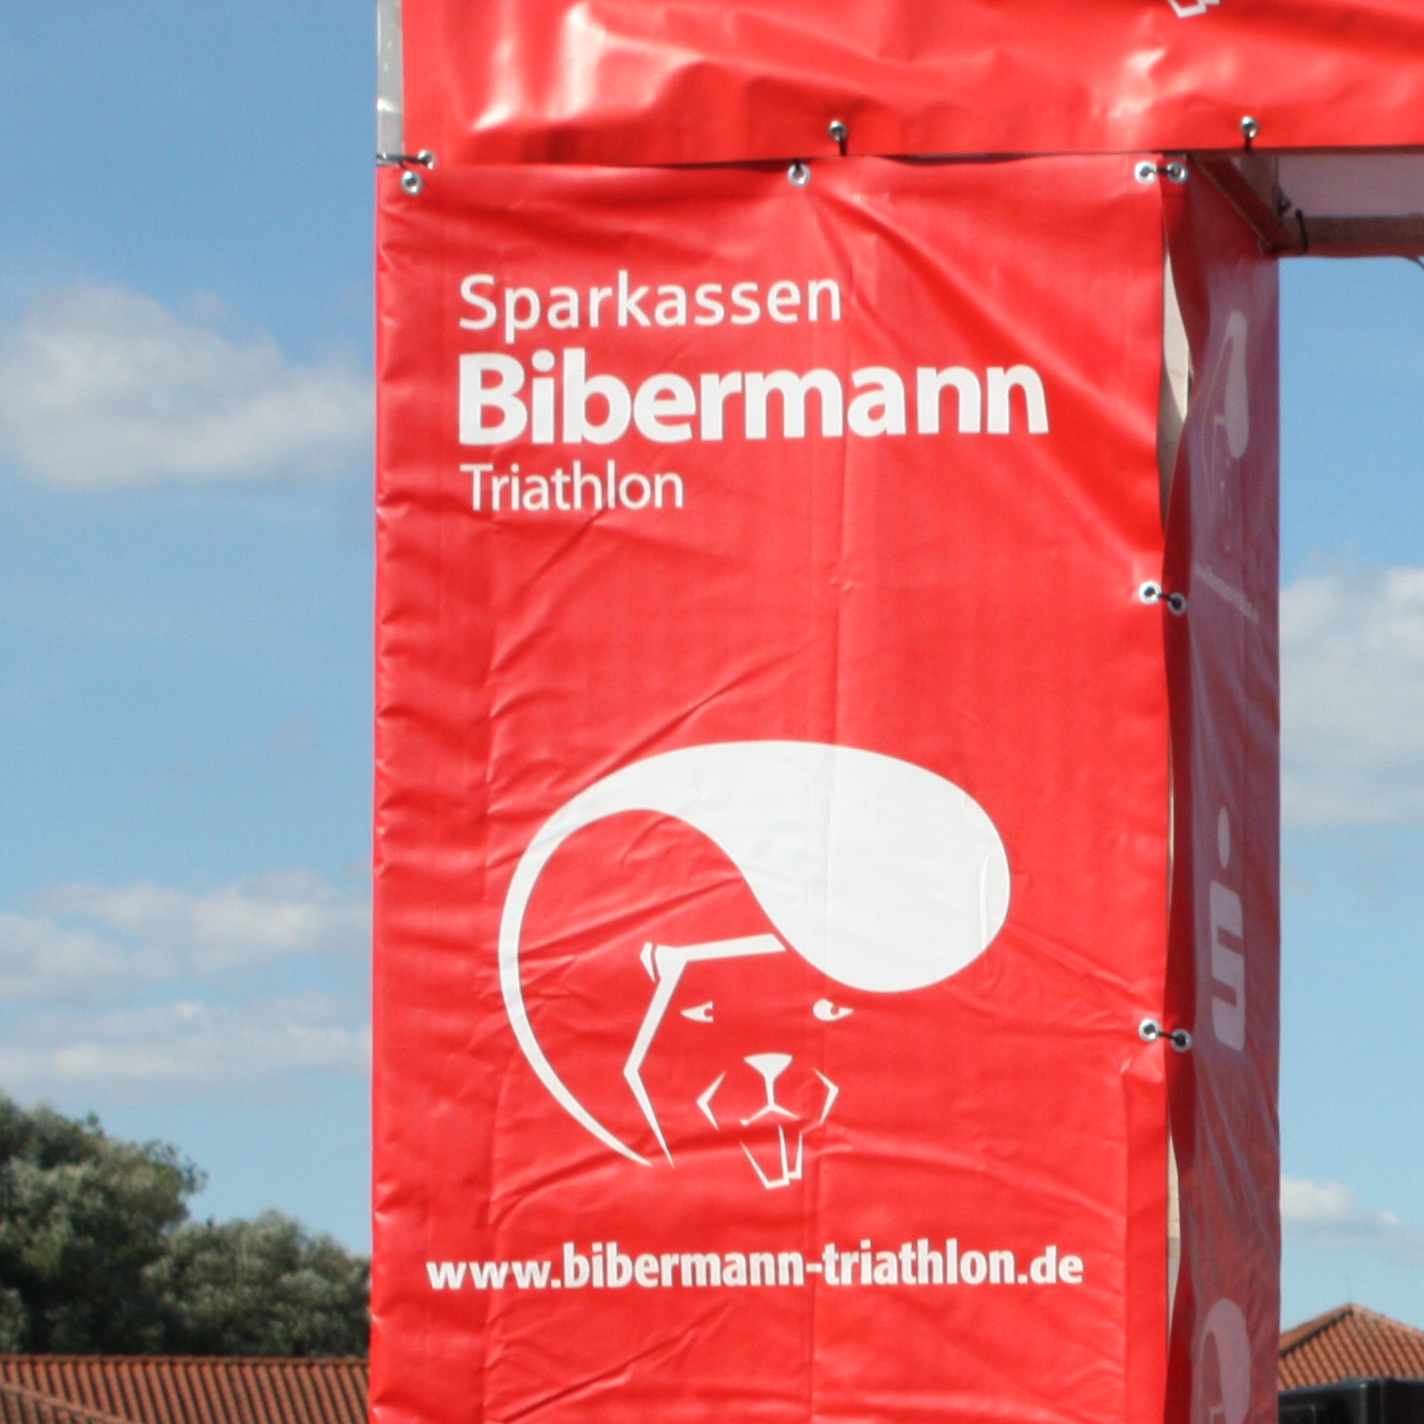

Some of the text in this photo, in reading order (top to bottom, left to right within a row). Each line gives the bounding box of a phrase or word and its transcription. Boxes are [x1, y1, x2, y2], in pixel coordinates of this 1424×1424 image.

[458, 269, 843, 343] Sparkassen
[457, 347, 1050, 446] Bibermann
[459, 458, 685, 513] Triathlon
[425, 1237, 1085, 1290] www.bibermann-triathlon.de
